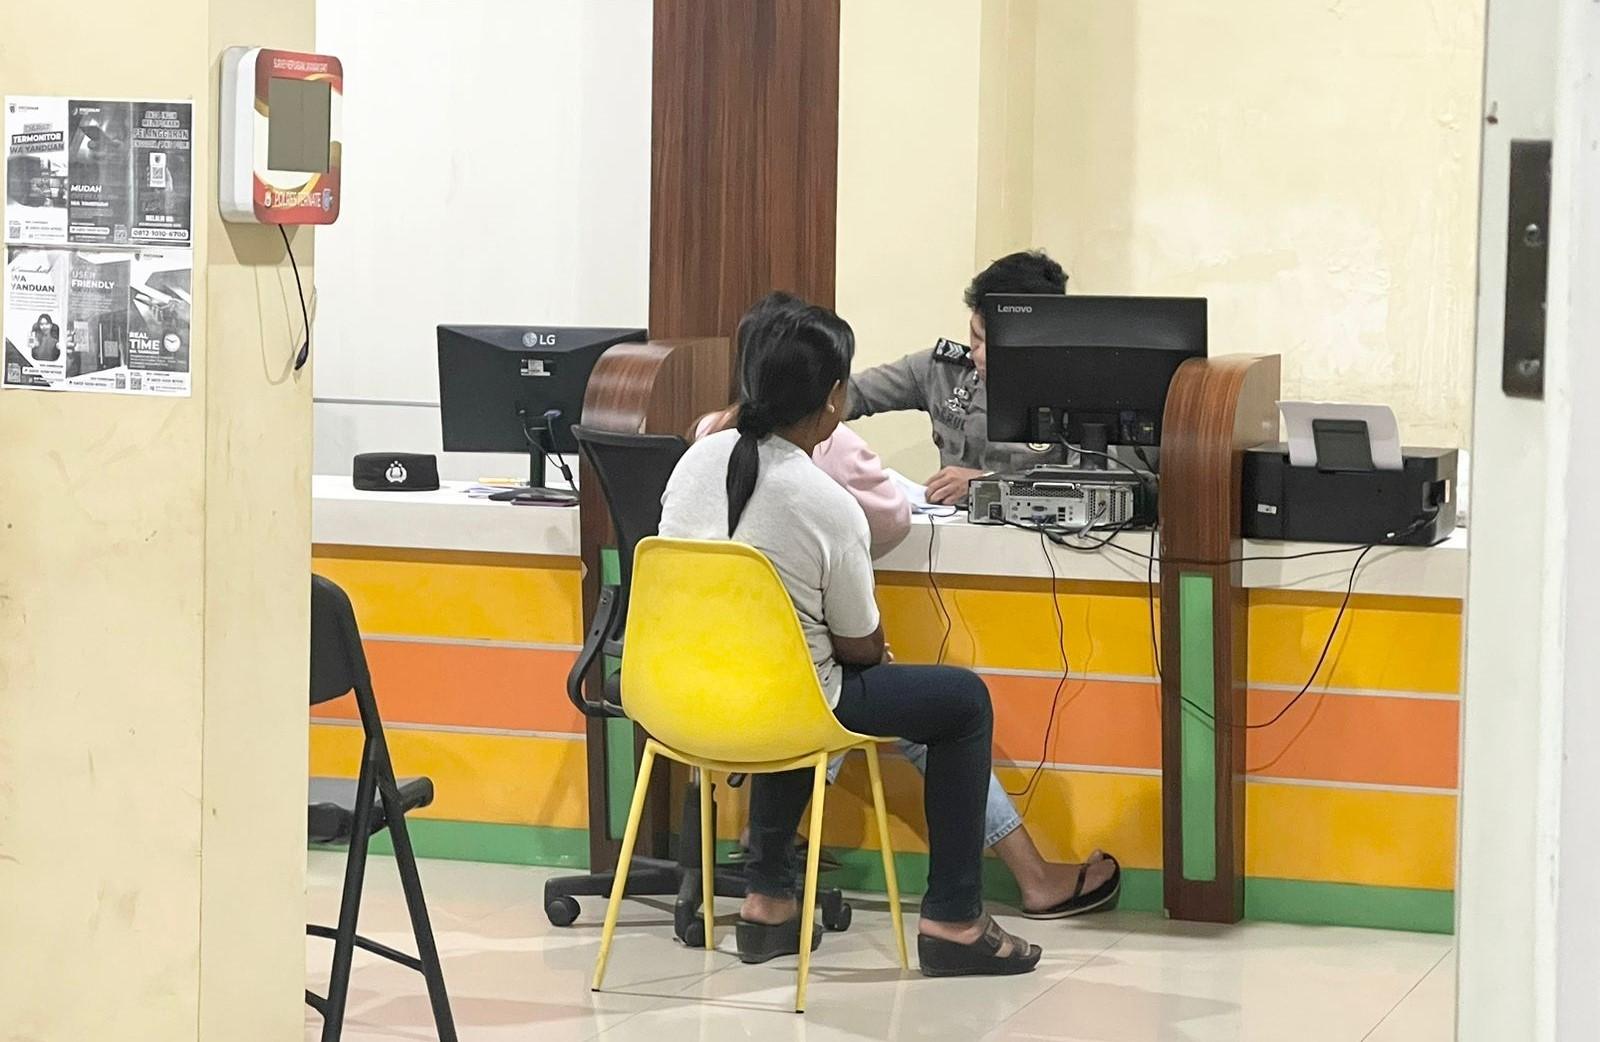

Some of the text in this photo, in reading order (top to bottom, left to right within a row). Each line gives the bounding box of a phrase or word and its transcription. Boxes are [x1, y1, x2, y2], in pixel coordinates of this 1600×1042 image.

[13, 132, 62, 144] TERMONITOR
[70, 184, 102, 193] MUDAH
[11, 282, 55, 292] YANDUAN
[71, 279, 115, 290] FRIENDLY
[997, 303, 1033, 313] Lenovo
[129, 339, 161, 351] TIME
[539, 334, 556, 345] LG
